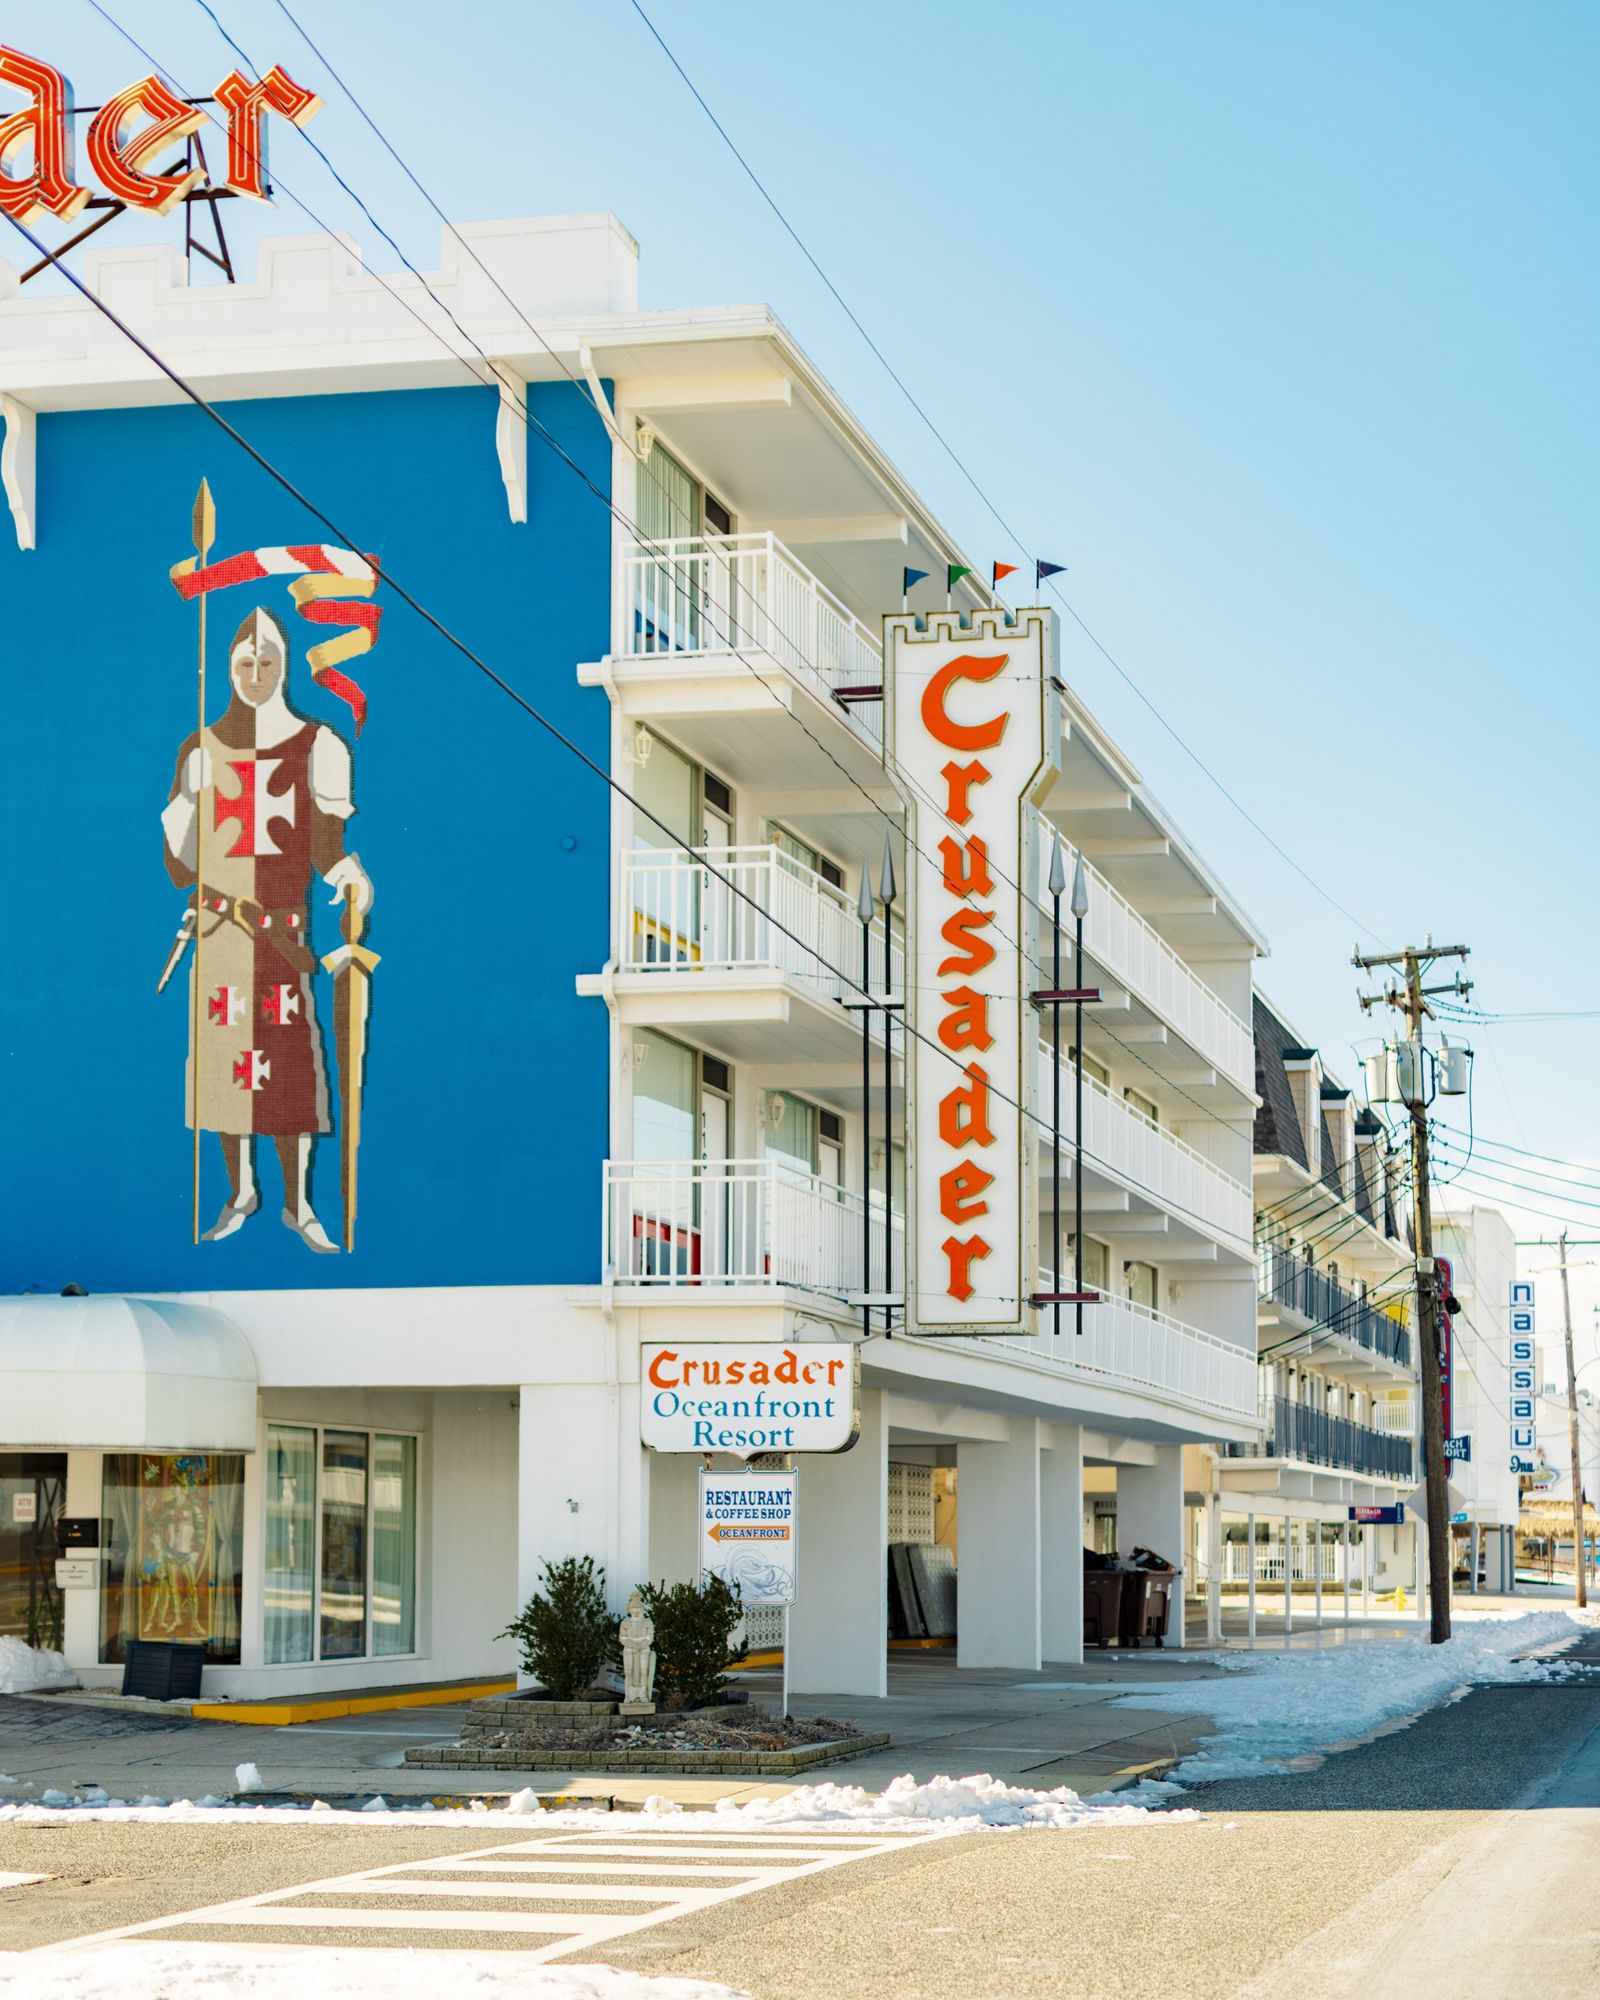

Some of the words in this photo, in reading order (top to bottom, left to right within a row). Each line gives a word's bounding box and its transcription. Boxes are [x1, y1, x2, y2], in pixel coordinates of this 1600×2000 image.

[919, 653, 1010, 1303] Crusader
[649, 1350, 844, 1389] Crusader
[652, 1391, 835, 1418] Oceanfront
[693, 1420, 795, 1447] Resort
[1443, 1448, 1467, 1458] ORT
[706, 1490, 792, 1506] RESTAURANT
[715, 1508, 759, 1519] COFFEE
[760, 1508, 791, 1519] SHOP
[719, 1529, 785, 1537] OCEANFRONT
